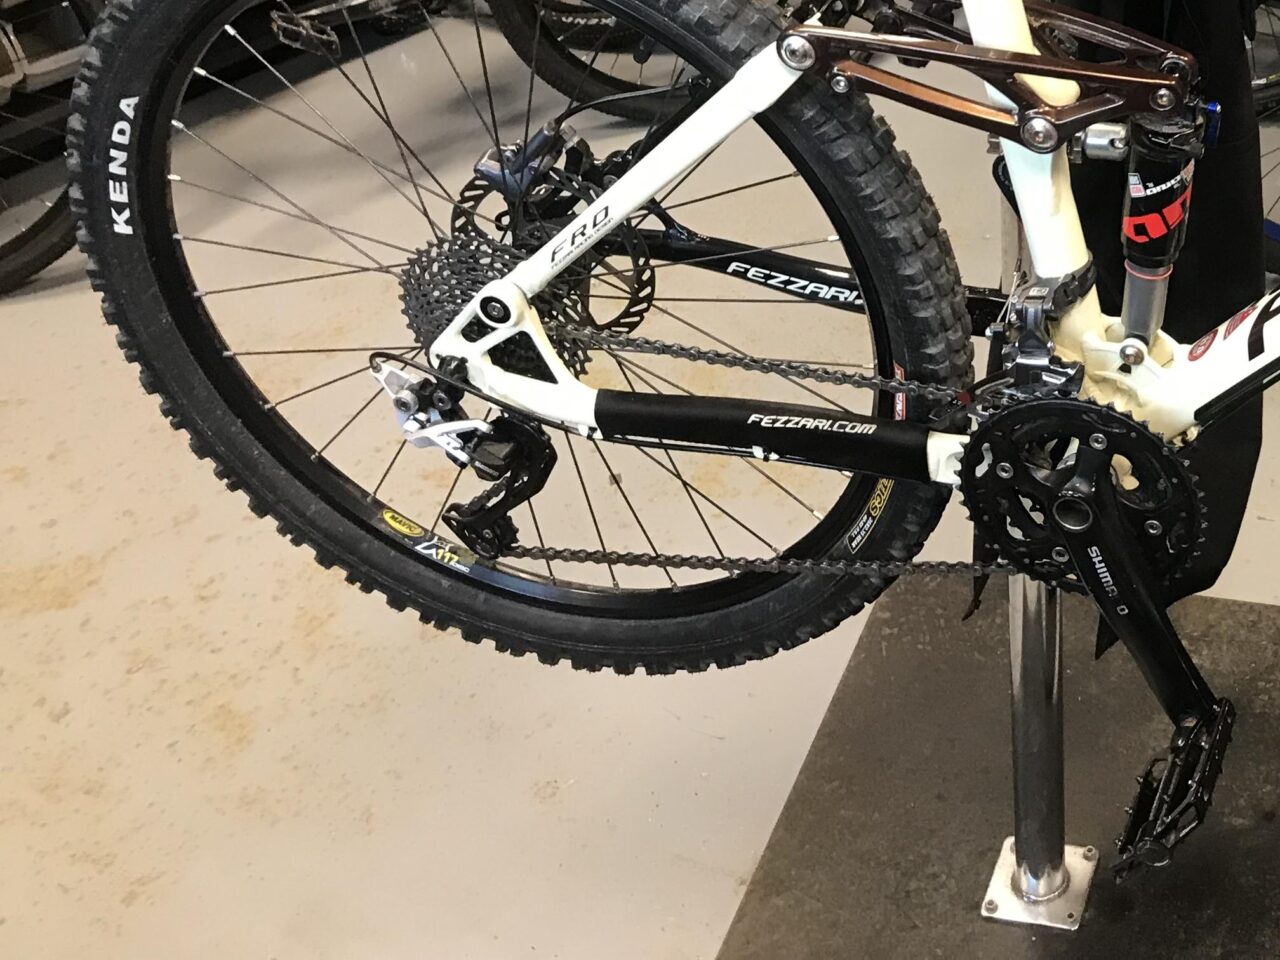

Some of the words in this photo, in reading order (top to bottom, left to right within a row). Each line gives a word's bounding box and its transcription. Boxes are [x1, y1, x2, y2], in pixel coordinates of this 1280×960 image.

[552, 12, 612, 25] KEND
[108, 95, 139, 235] KENDA
[747, 413, 877, 435] FEZZARI.COM
[389, 513, 418, 533] MAVIC
[1086, 545, 1129, 617] SHIMAO
